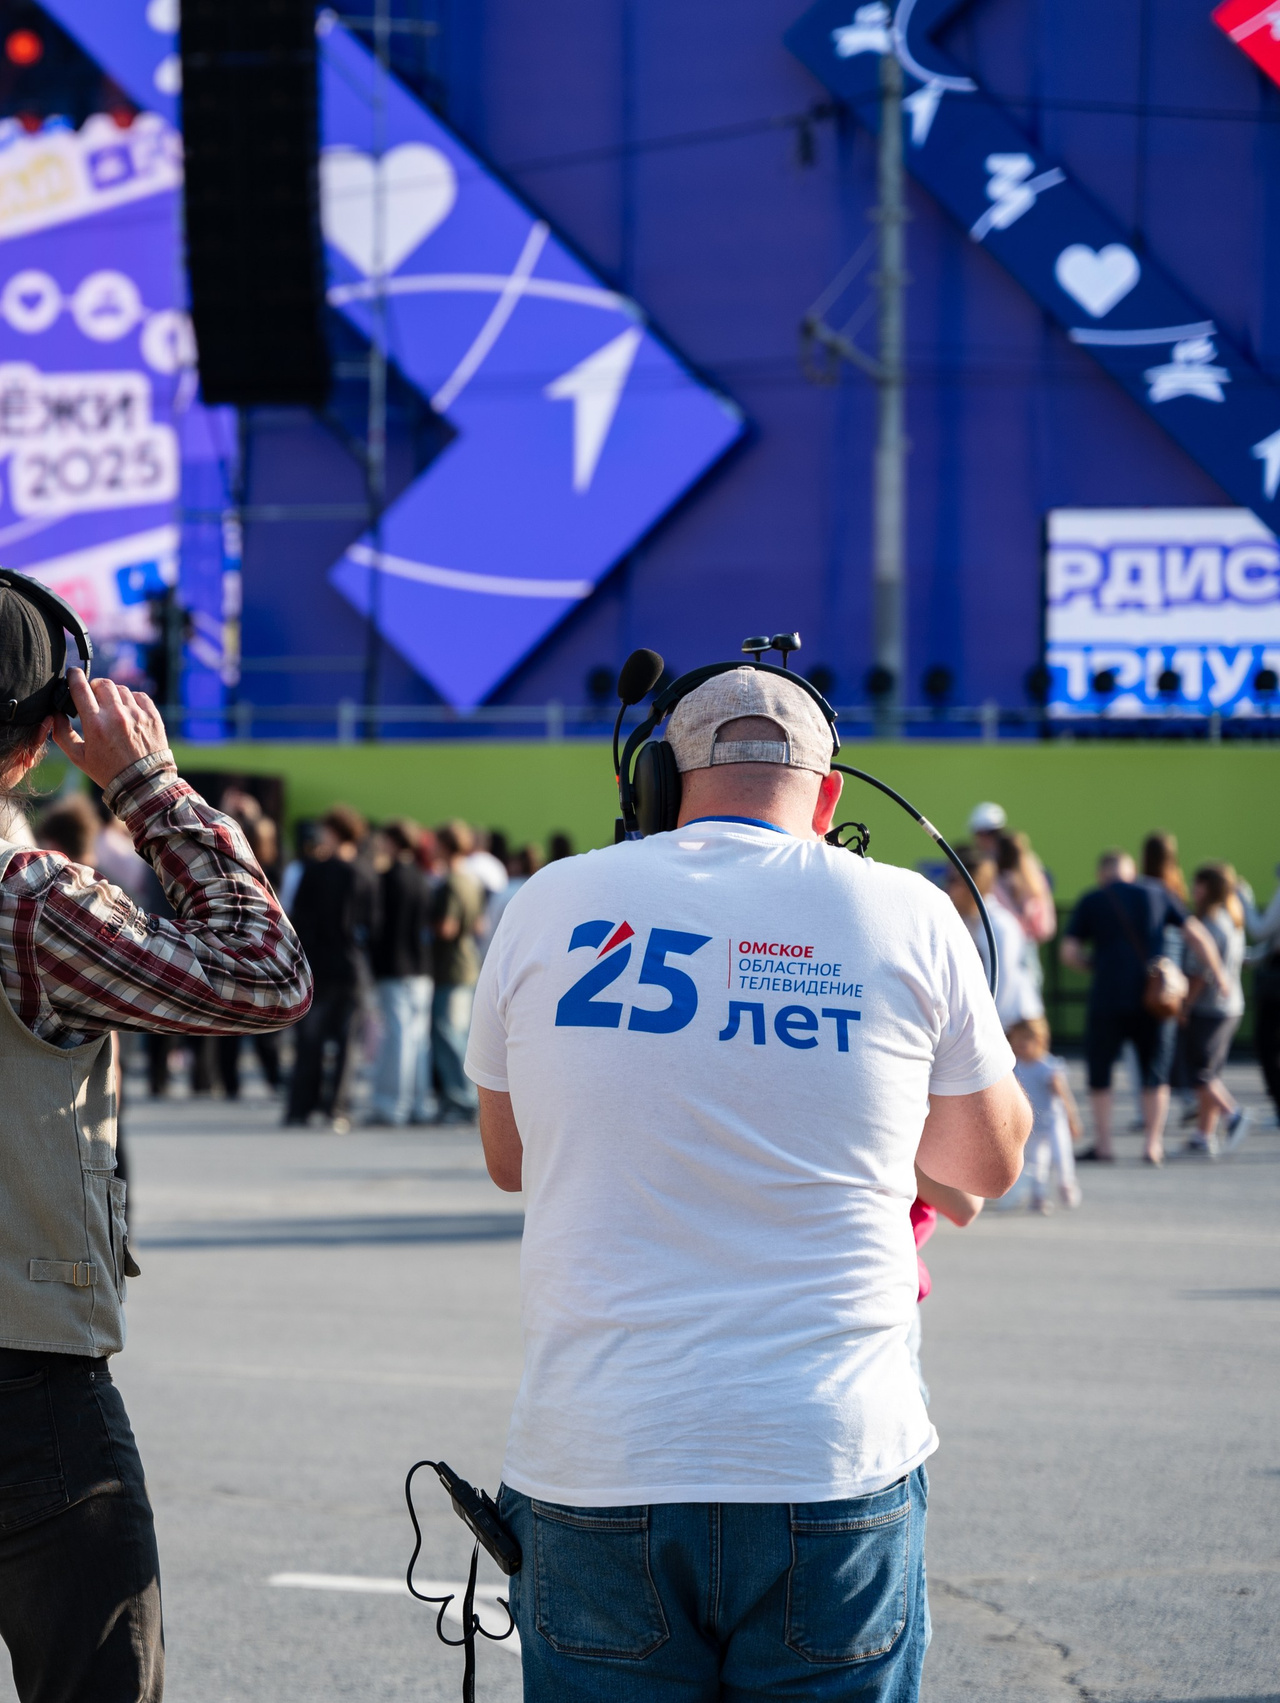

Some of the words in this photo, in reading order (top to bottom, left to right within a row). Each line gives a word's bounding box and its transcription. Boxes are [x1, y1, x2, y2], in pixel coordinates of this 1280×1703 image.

[26, 438, 163, 498] 2025
[1046, 649, 1280, 708] ПРИУ
[738, 940, 815, 959] ОМСКОЕ
[738, 958, 842, 977] ОБЛАСТНОЕ
[555, 920, 713, 1034] 25
[739, 975, 864, 998] ТЕЛЕВИДЕНИЕ
[719, 1000, 862, 1052] лет
